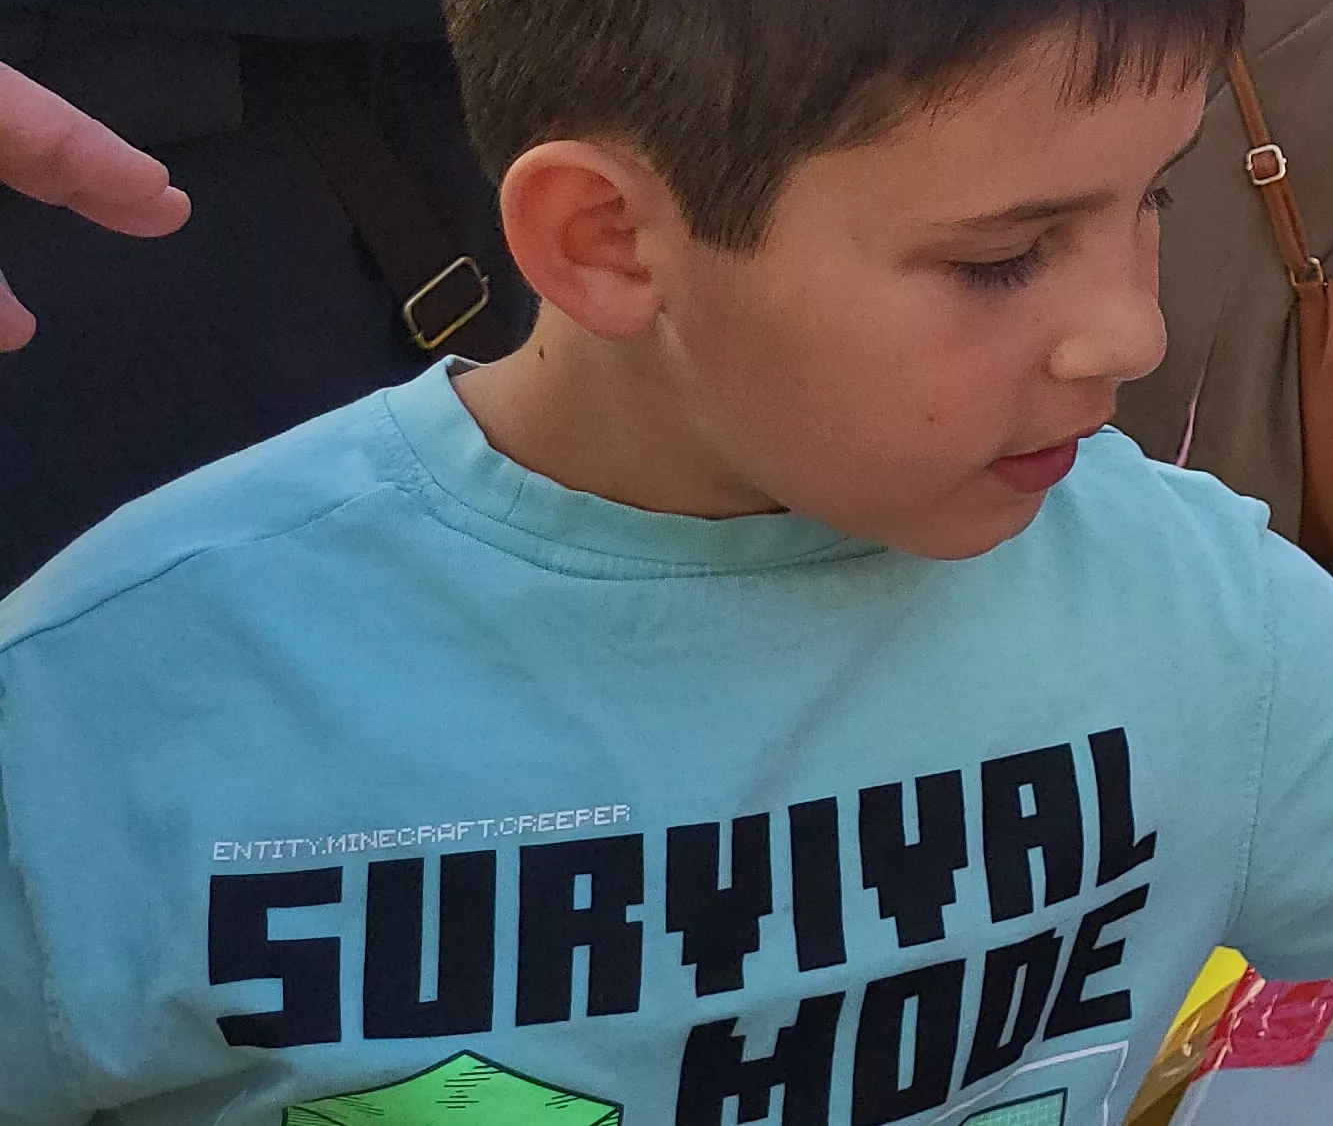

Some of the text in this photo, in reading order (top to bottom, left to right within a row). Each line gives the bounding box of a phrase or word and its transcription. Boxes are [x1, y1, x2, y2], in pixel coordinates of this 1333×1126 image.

[207, 727, 1158, 1048] SURVIVAL
[212, 803, 631, 861] ENTITY.MINECRAFT.CREEPER
[675, 882, 1151, 1126] MODE
